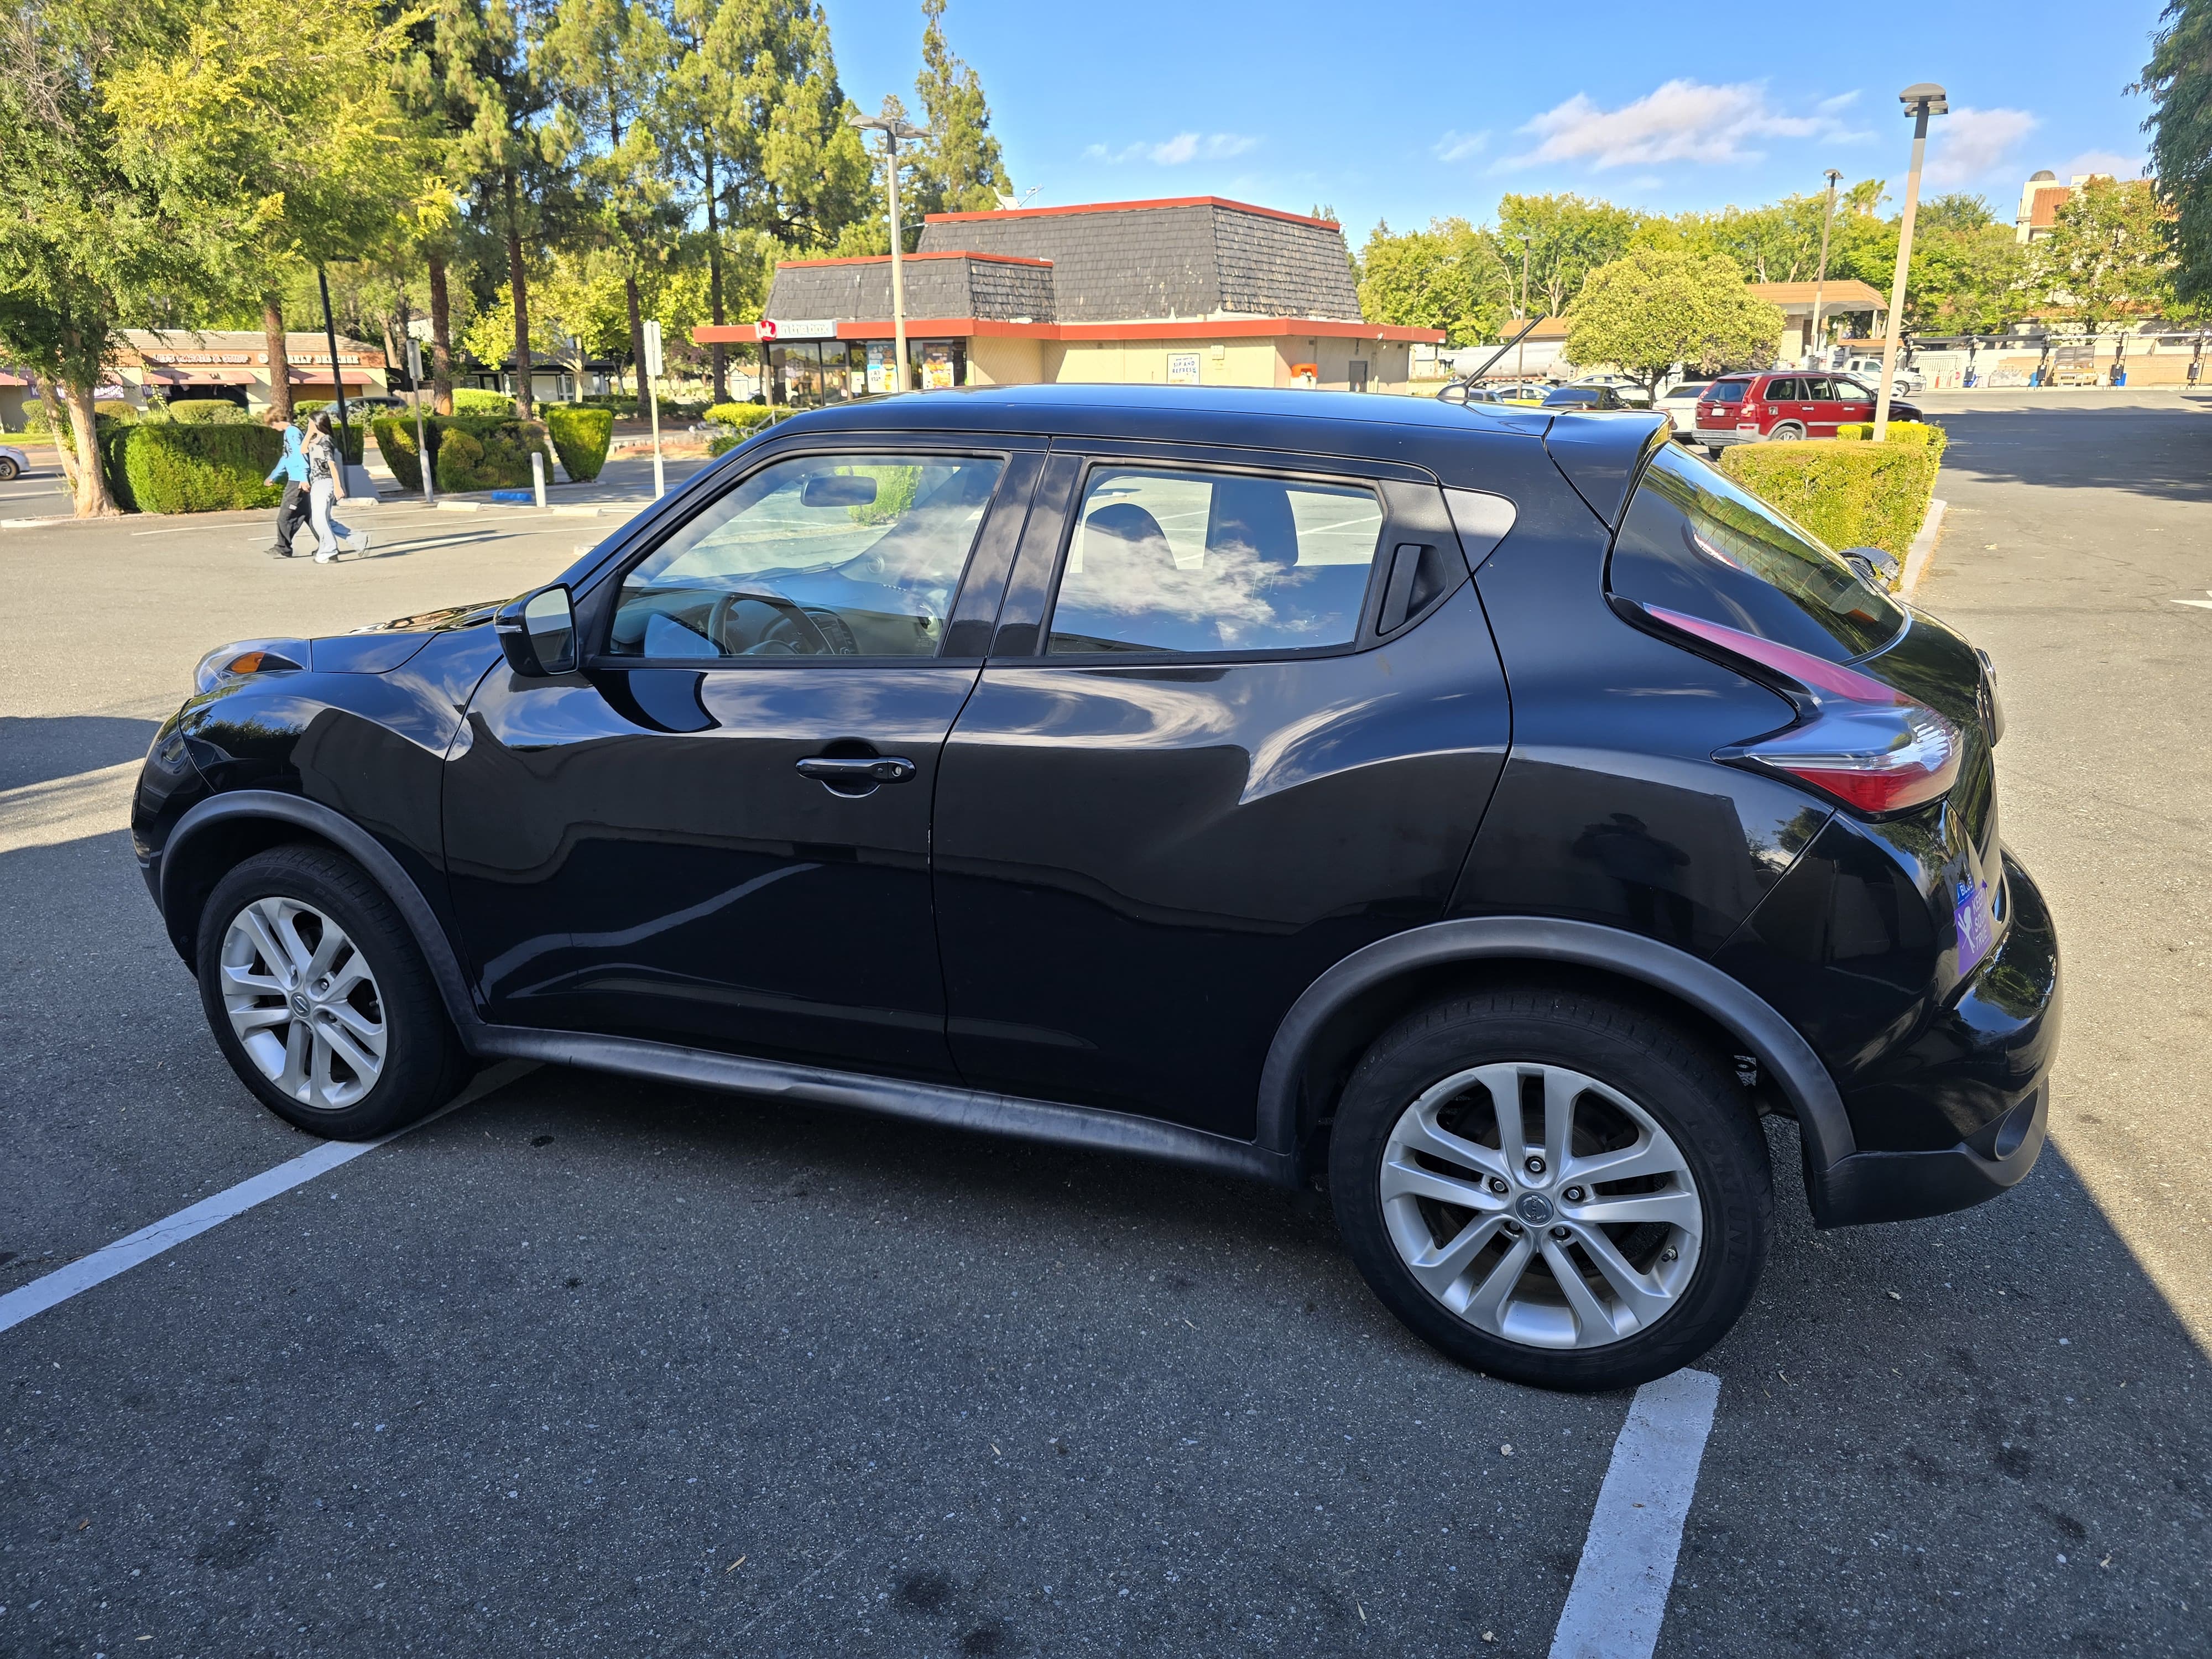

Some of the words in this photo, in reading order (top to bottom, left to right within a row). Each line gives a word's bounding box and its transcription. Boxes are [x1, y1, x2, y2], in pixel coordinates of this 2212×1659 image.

[314, 354, 360, 364] DEFNSE
[1972, 889, 1984, 915] KEEP
[1975, 924, 1987, 950] TRUE
